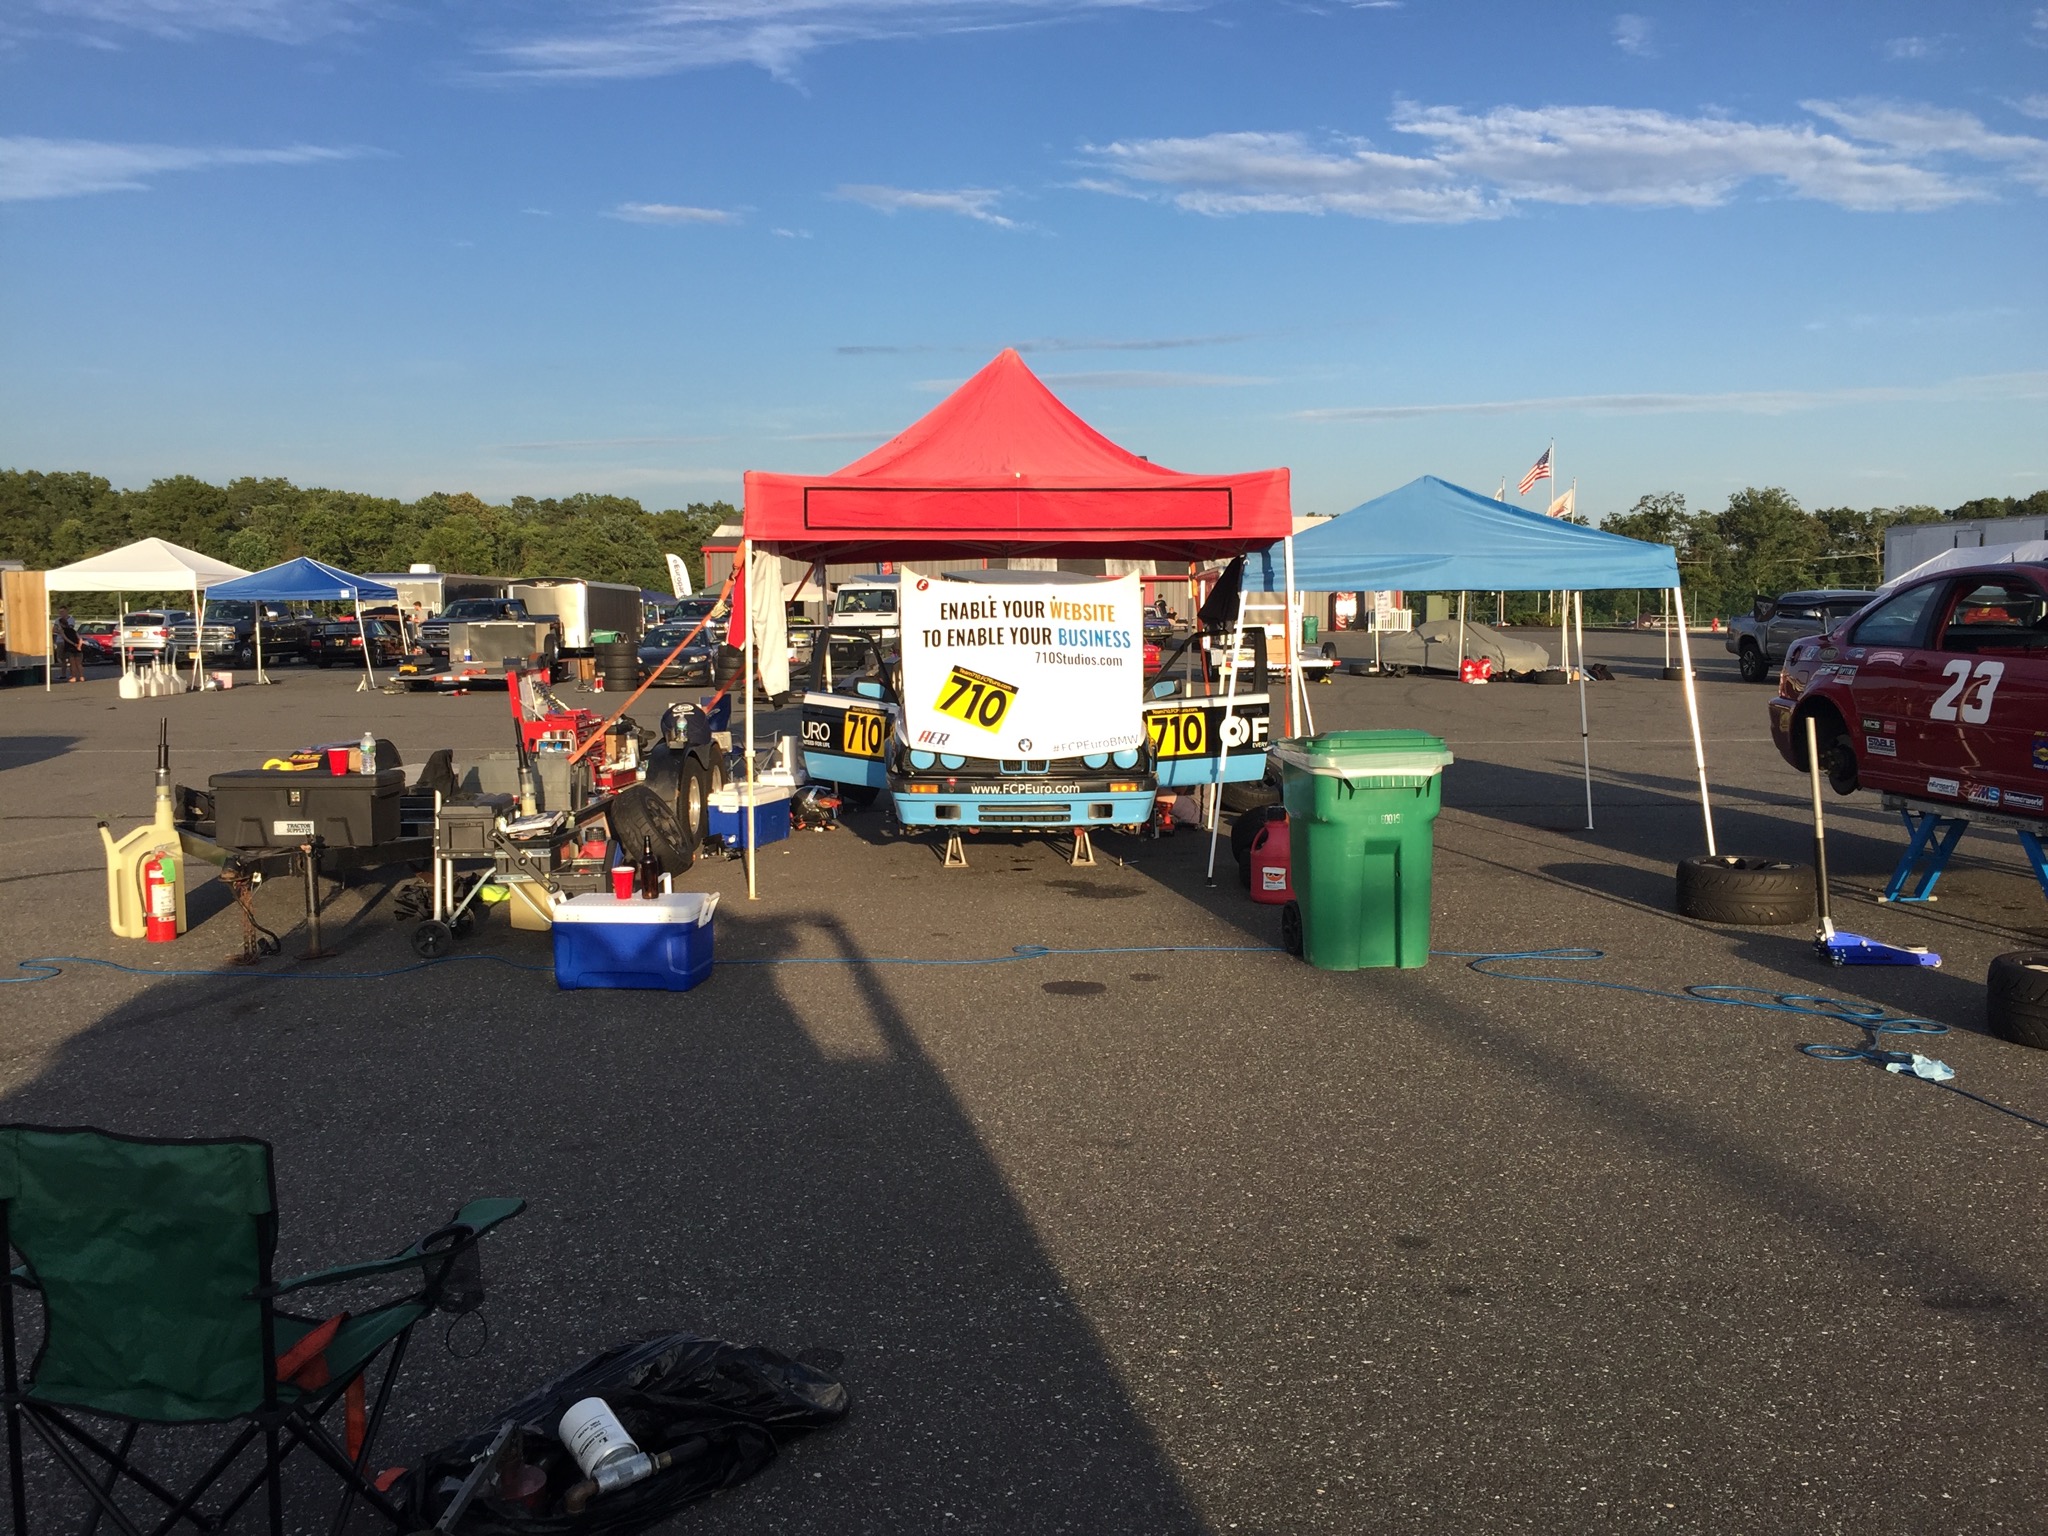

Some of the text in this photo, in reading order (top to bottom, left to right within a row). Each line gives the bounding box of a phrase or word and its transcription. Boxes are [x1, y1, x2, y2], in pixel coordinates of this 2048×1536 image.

[940, 600, 1115, 622] ENABLE YOUR WEBSITE
[923, 627, 1131, 649] TO ENABLE YOUR BUSINESS
[1035, 652, 1123, 667] 710Studios.com
[939, 674, 1007, 727] 710
[1930, 659, 2005, 724] 23
[802, 720, 831, 741] URO
[847, 713, 882, 754] 710
[1151, 714, 1202, 753] 710
[1863, 719, 1880, 729] MCS
[917, 730, 951, 745] AER
[1053, 734, 1138, 752] #FCPEuroBMW
[1867, 737, 1895, 749] STABLE
[971, 783, 1081, 794] www.FCPEuro.com
[1968, 784, 2000, 801] HMS
